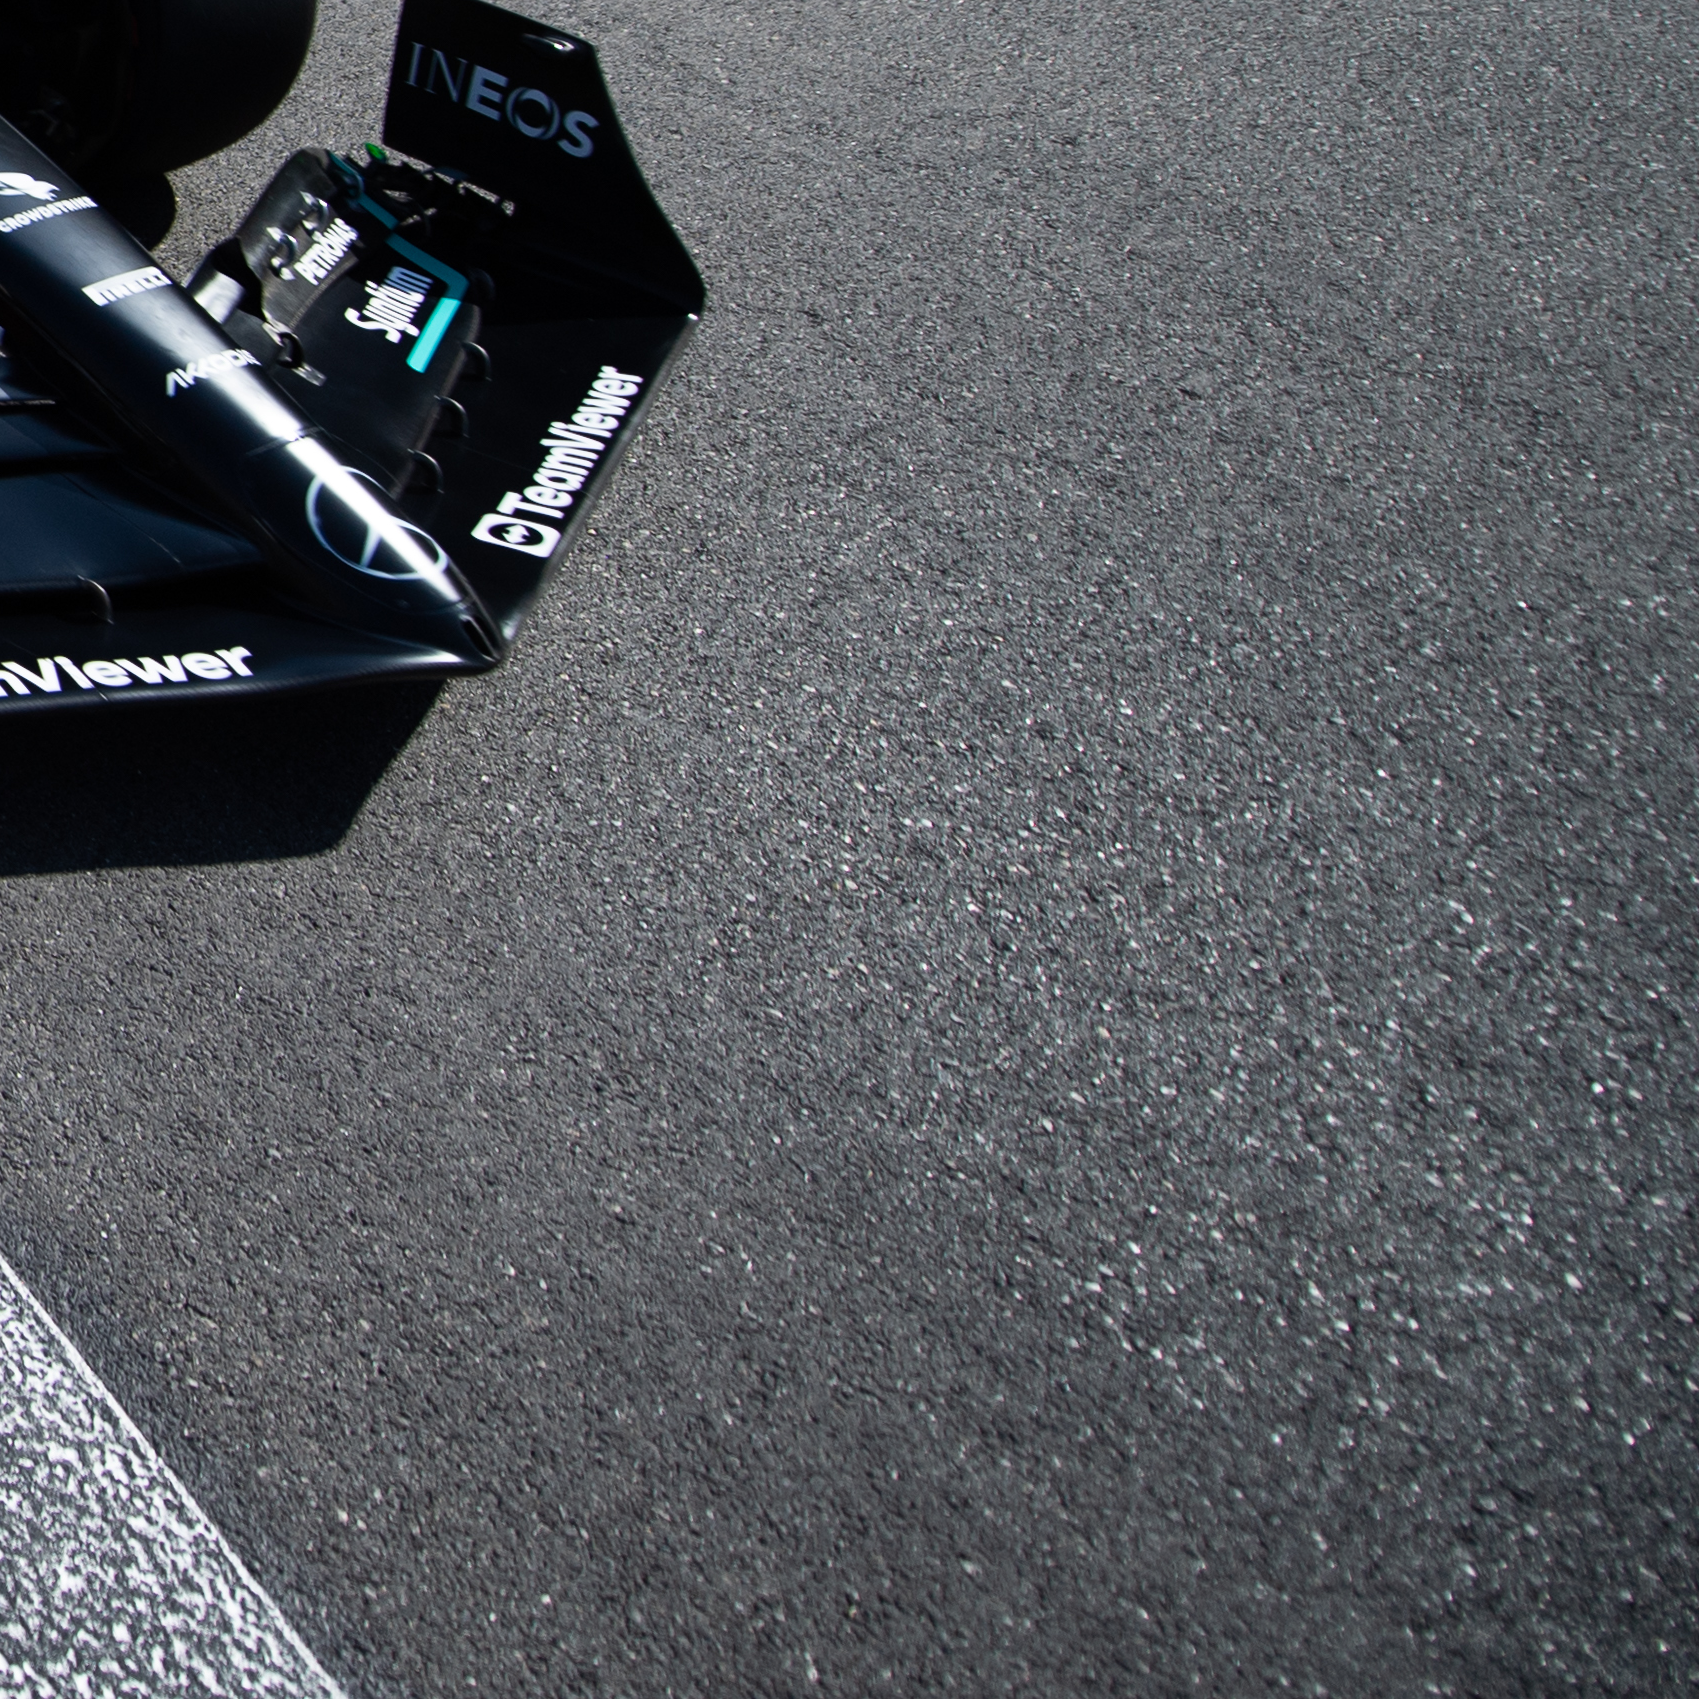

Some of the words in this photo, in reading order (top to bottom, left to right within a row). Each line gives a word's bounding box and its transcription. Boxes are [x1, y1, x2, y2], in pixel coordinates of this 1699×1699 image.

[404, 40, 601, 160] INEOS
[293, 218, 360, 285] PETRONAS
[343, 265, 435, 344] Syntium
[495, 365, 644, 523] TeamViewer
